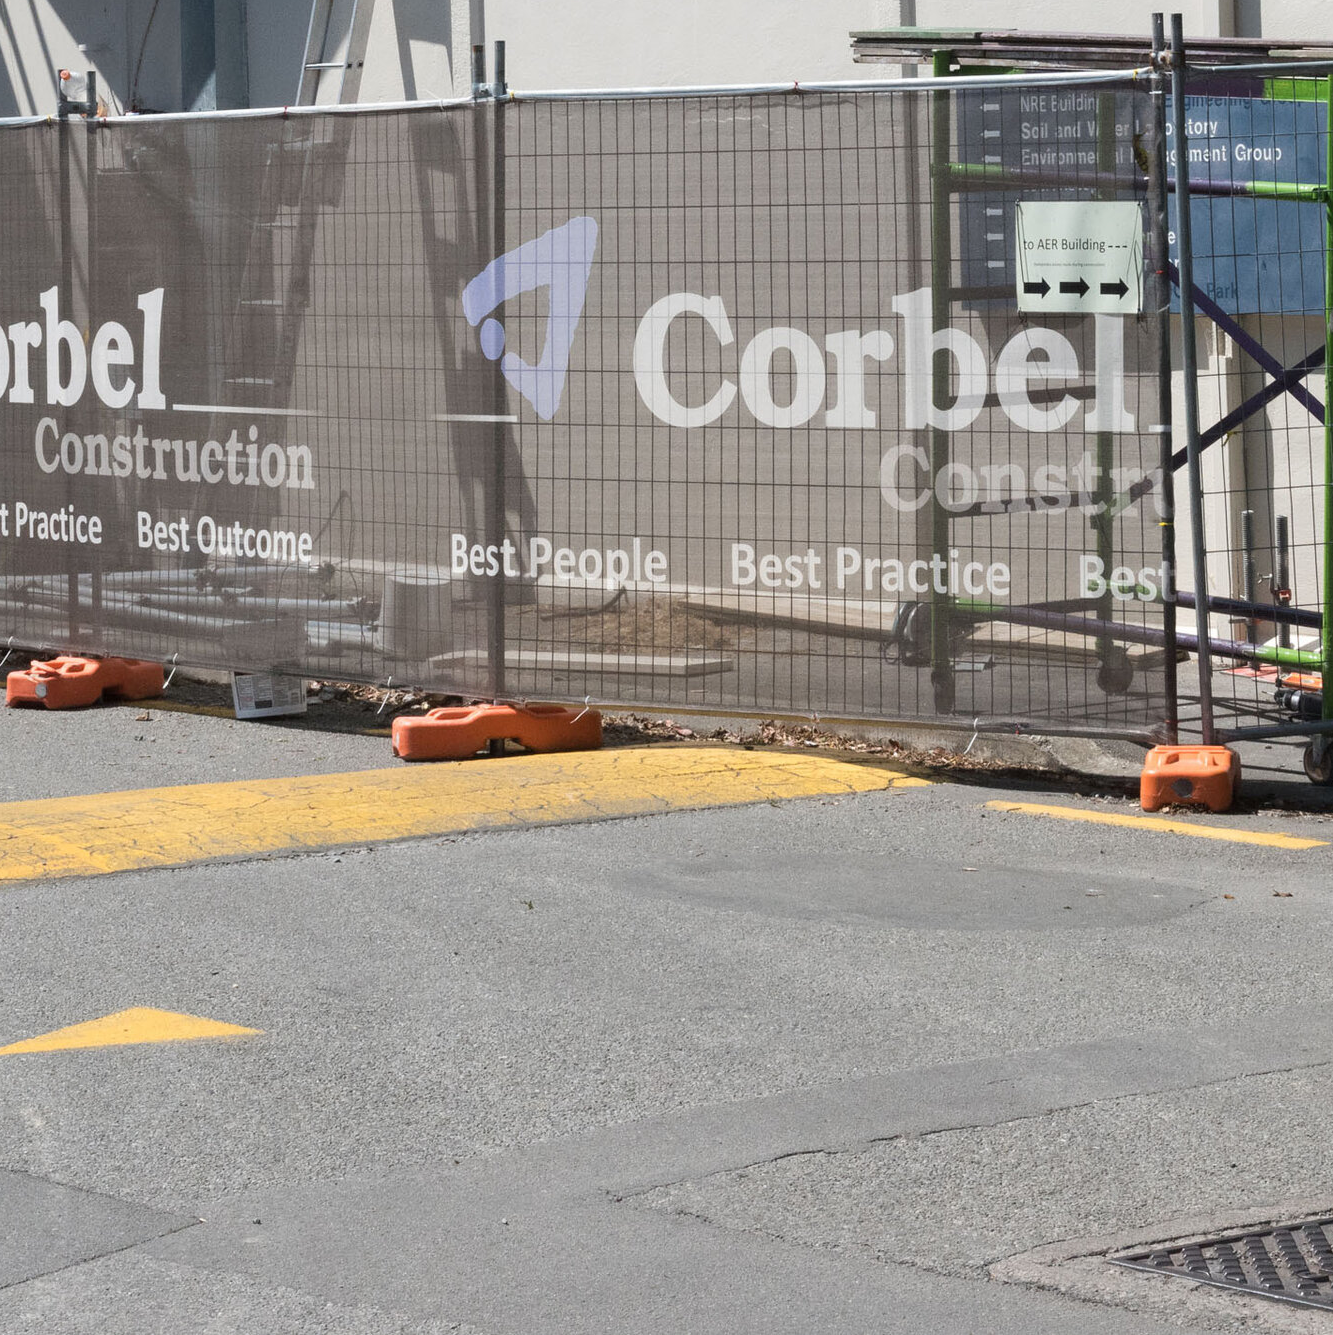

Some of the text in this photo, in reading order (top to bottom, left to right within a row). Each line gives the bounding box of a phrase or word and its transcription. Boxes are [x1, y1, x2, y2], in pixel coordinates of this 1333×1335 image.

[1020, 95, 1047, 113] NRE
[1021, 121, 1048, 139] Soil
[1056, 122, 1081, 138] and
[1234, 143, 1283, 162] Group
[1024, 240, 1034, 250] to
[1037, 238, 1058, 250] AER
[1061, 238, 1106, 254] Building
[632, 290, 1135, 433] Corbel
[34, 416, 316, 490] Construction
[14, 502, 103, 544] Practice
[137, 511, 190, 551] Best
[196, 515, 313, 563] Outcome
[450, 533, 1179, 603] Best People Best Practice Best
